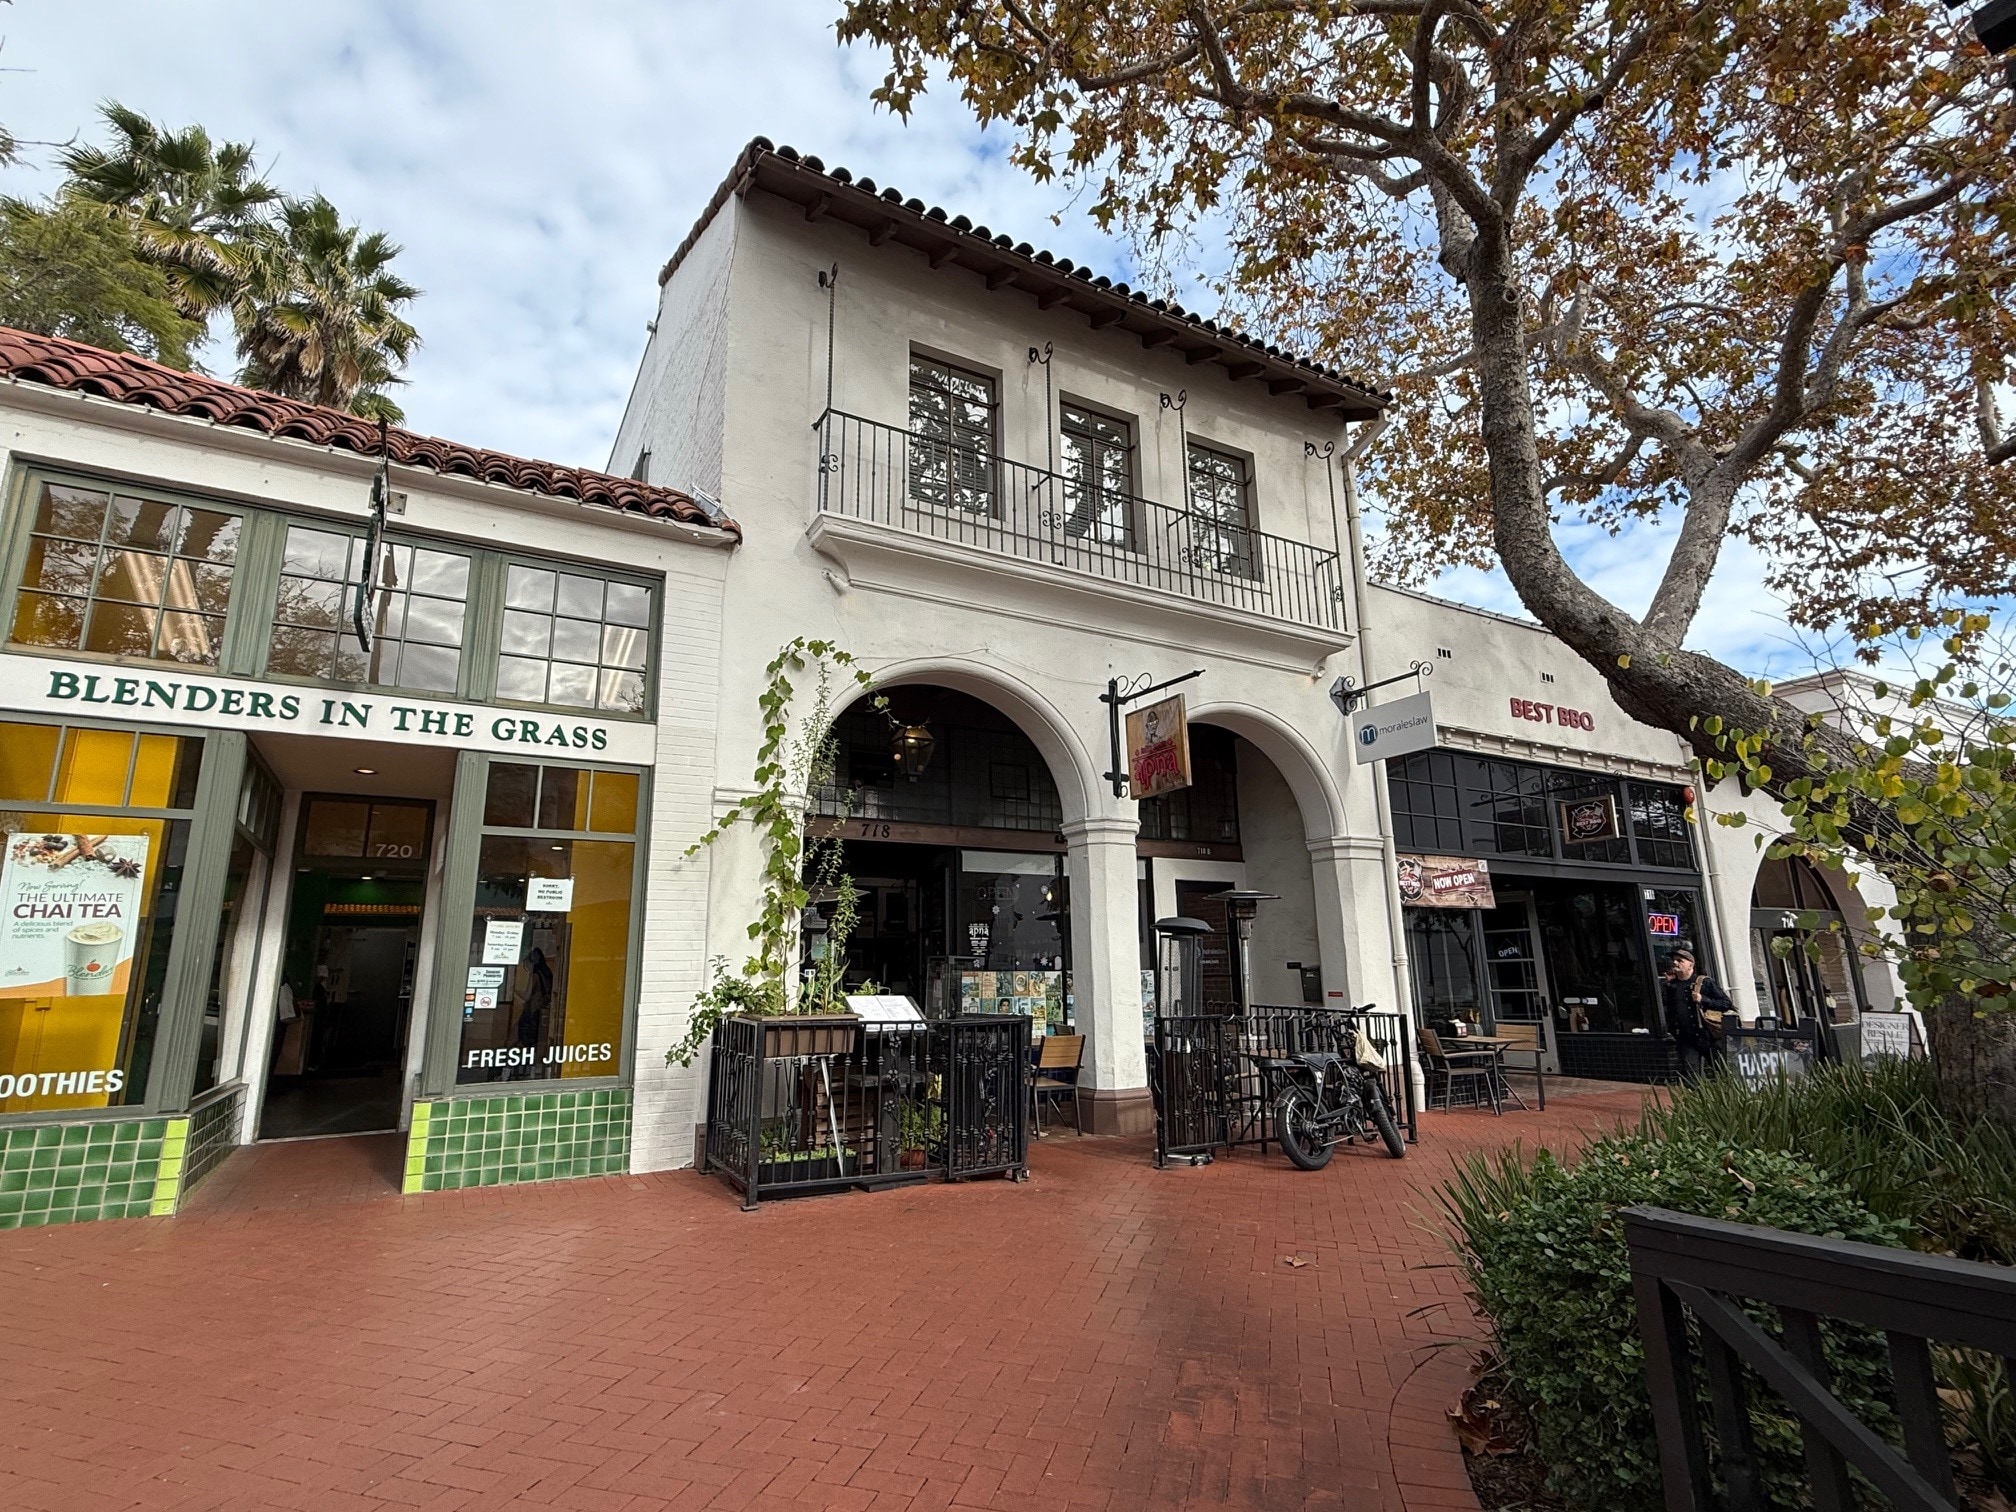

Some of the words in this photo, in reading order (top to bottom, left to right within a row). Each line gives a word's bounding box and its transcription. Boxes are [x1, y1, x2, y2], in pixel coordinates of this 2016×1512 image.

[46, 670, 300, 719] BLENDERS
[319, 699, 373, 728] IN
[390, 706, 474, 736] THE
[491, 717, 608, 750] GRASS
[1510, 697, 1554, 724] BEST
[1557, 706, 1595, 732] BBQ
[1379, 715, 1428, 735] moraleslaw
[1134, 750, 1180, 790] apna
[862, 823, 891, 838] 718
[376, 843, 413, 858] 720
[18, 882, 41, 891] Now
[1433, 876, 1452, 890] NOW
[1453, 873, 1475, 887] OPEN
[18, 893, 47, 902] THE
[52, 893, 124, 902] ULTIMATE
[13, 904, 72, 918] CHAI
[78, 904, 122, 918] TEA
[1649, 916, 1676, 932] OPEN
[968, 927, 990, 938] apna
[1498, 947, 1519, 958] OPEN
[467, 1047, 535, 1068] FRESH
[542, 1043, 612, 1064] JUICES
